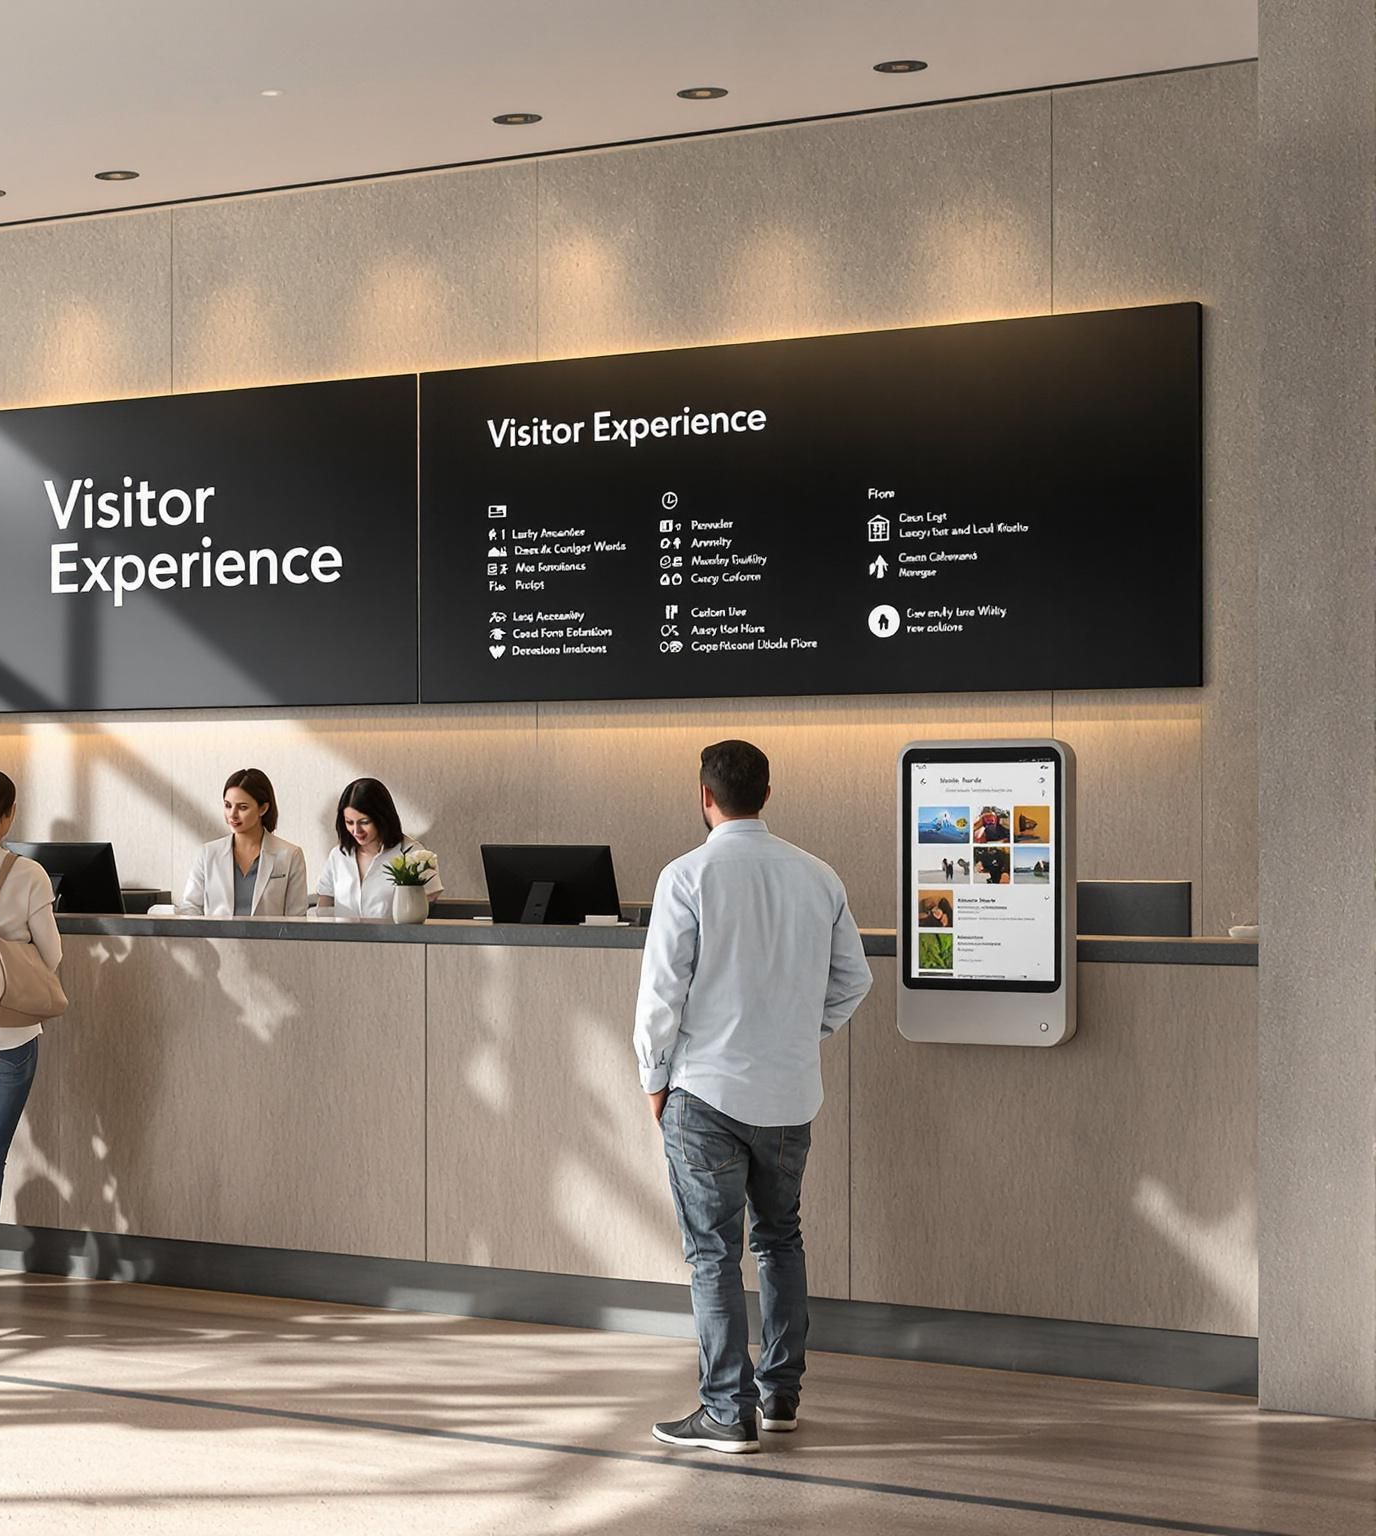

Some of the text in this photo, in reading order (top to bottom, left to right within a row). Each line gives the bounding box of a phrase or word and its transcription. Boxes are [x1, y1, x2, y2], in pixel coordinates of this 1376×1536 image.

[487, 407, 766, 447] Visitor Experience
[43, 475, 214, 529] Visitor
[952, 524, 970, 535] and
[51, 537, 342, 607] Experience
